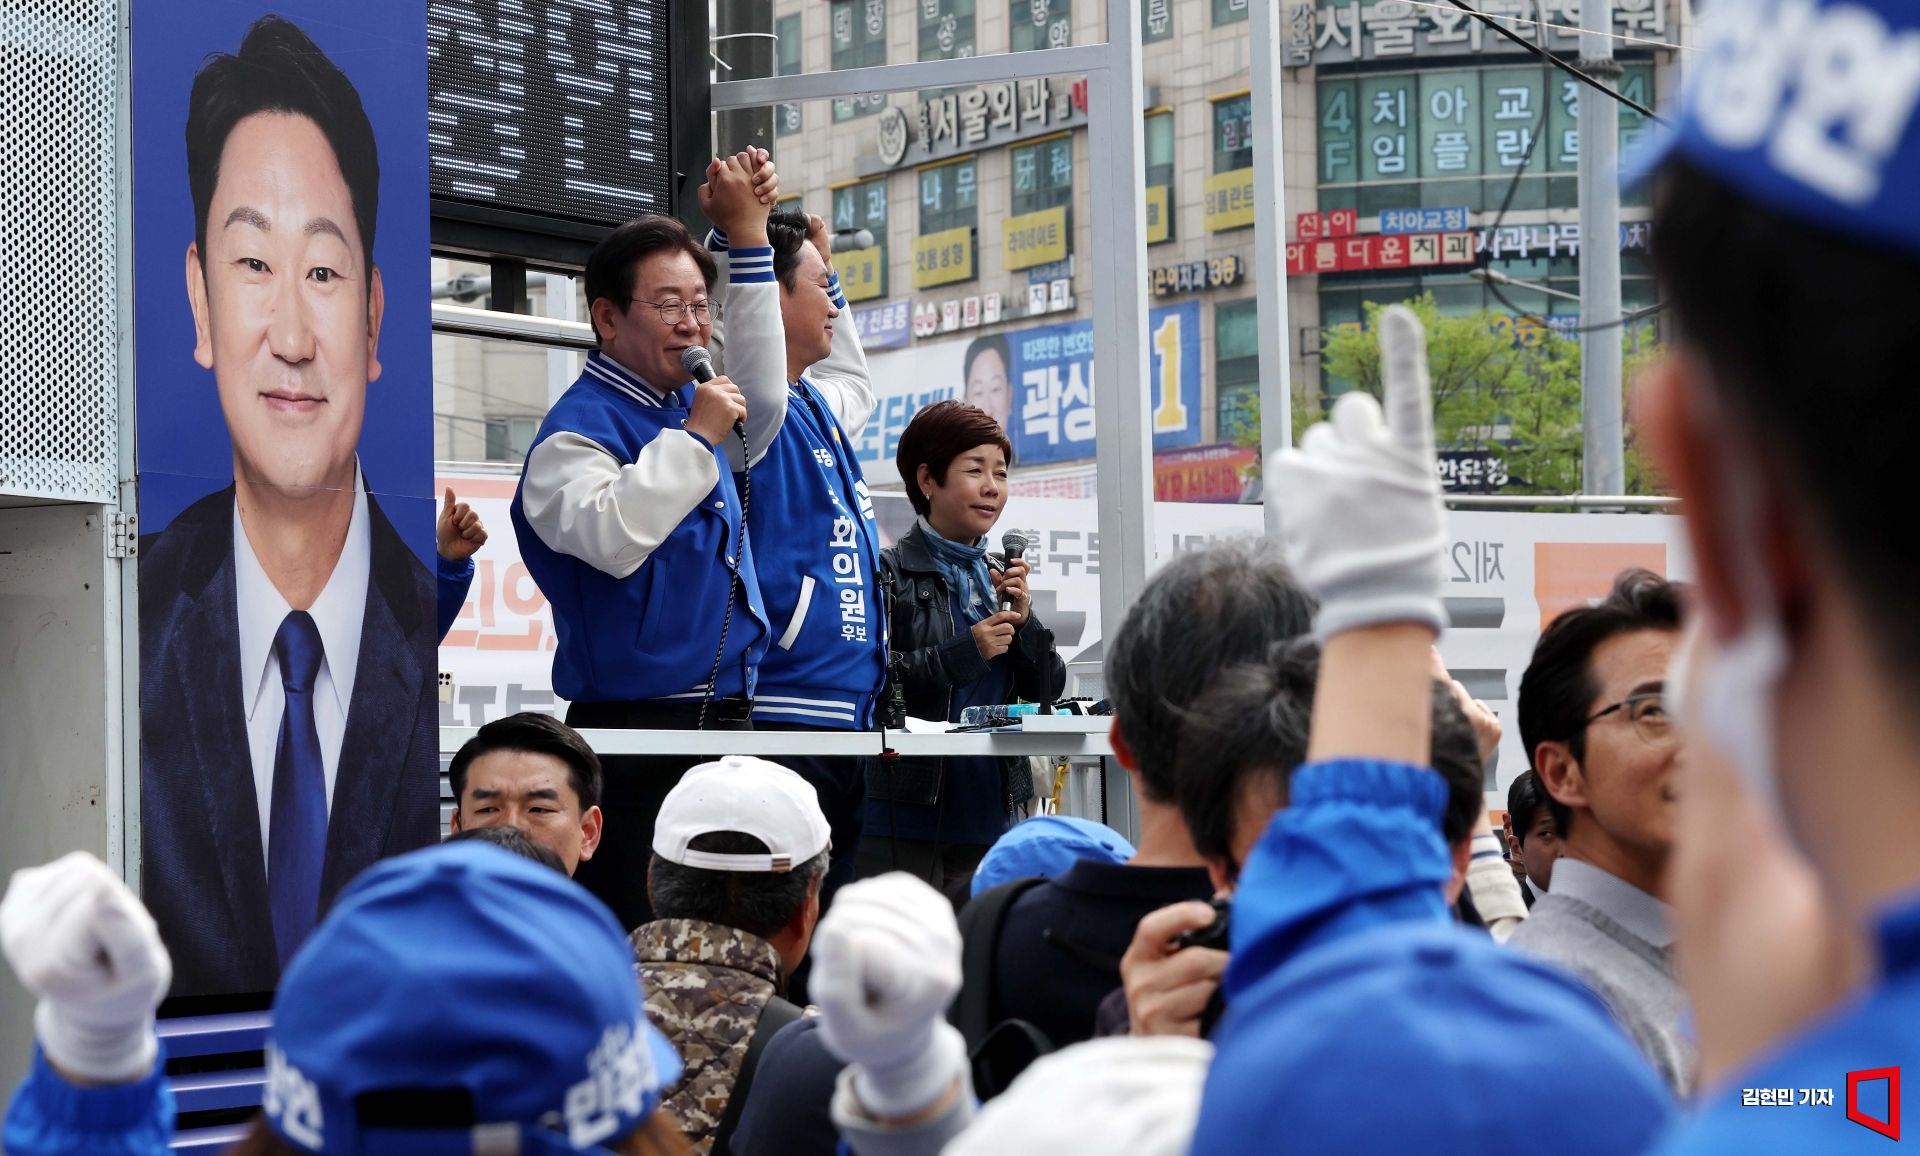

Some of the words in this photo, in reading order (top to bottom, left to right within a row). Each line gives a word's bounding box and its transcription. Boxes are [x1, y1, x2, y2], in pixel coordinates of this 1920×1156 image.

[934, 78, 1049, 148] 서울외과
[1386, 207, 1463, 231] 치아교정
[1153, 314, 1188, 435] 1
[841, 623, 867, 642] 후보
